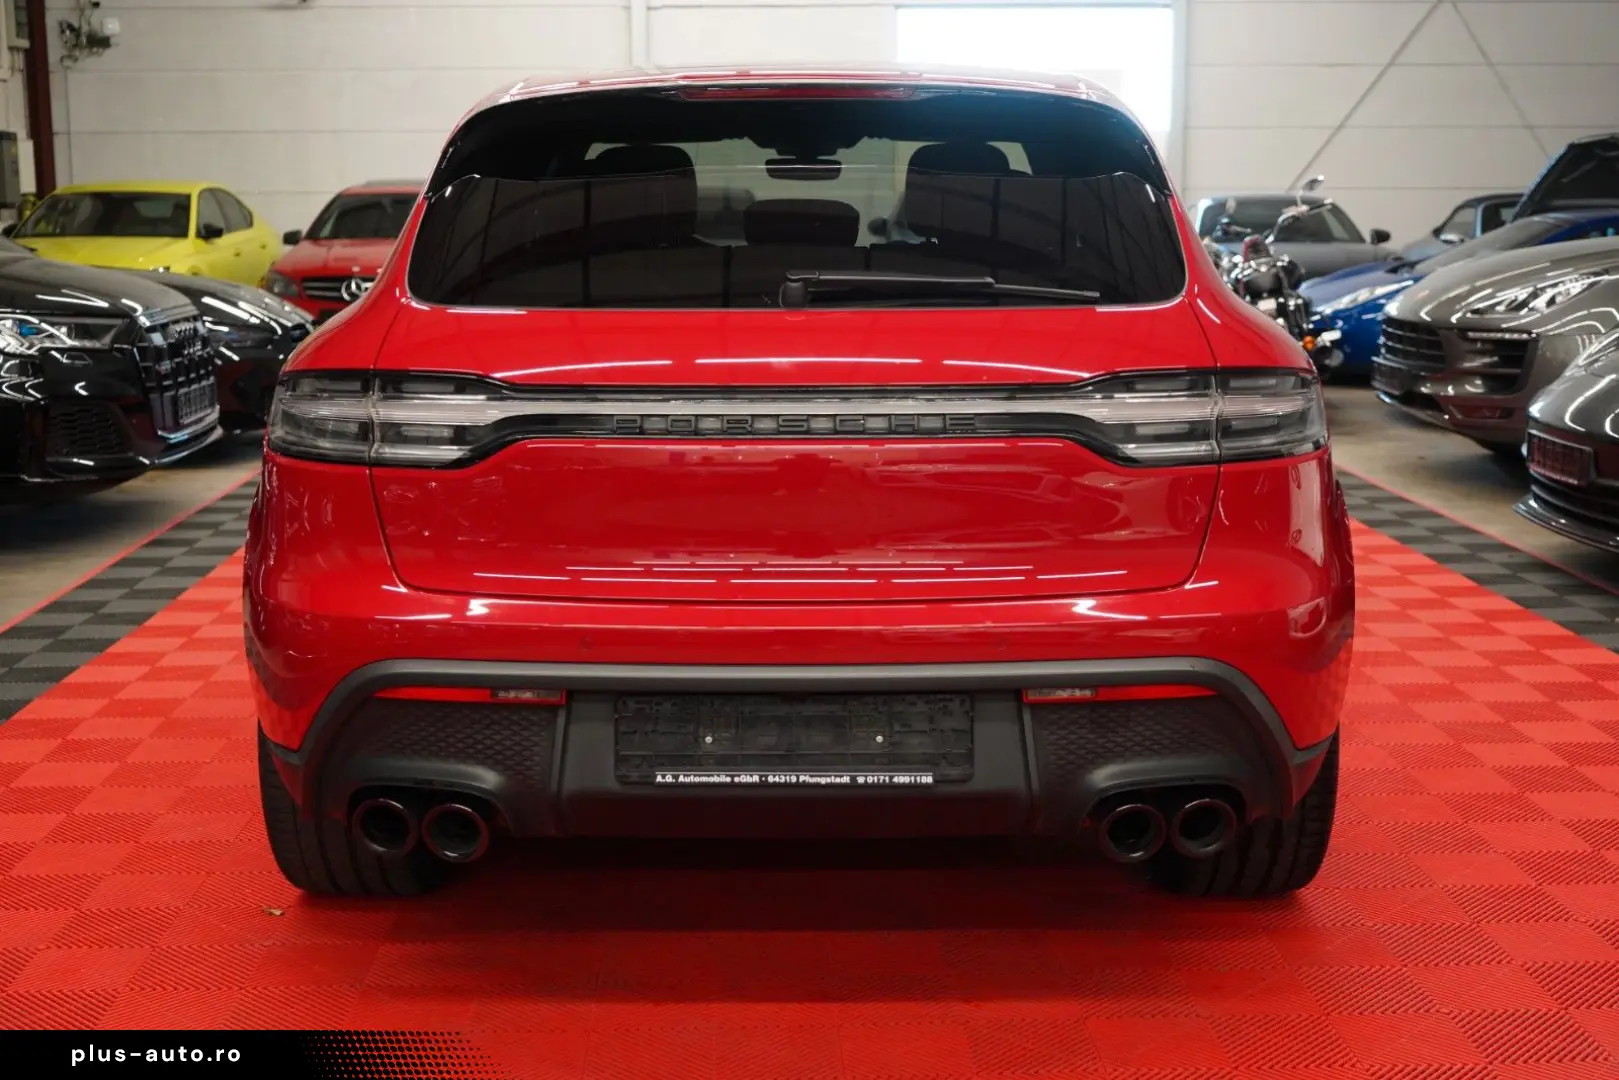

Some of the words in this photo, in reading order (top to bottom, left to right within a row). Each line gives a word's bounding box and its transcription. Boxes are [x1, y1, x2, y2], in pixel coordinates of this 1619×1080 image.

[612, 414, 976, 433] PORSCHE
[656, 774, 676, 783] A.G.
[678, 774, 732, 783] Automobile
[734, 774, 760, 783] eGbR
[767, 775, 797, 783] 64319
[799, 775, 851, 785] Pfungstadt
[866, 775, 890, 784] 0171
